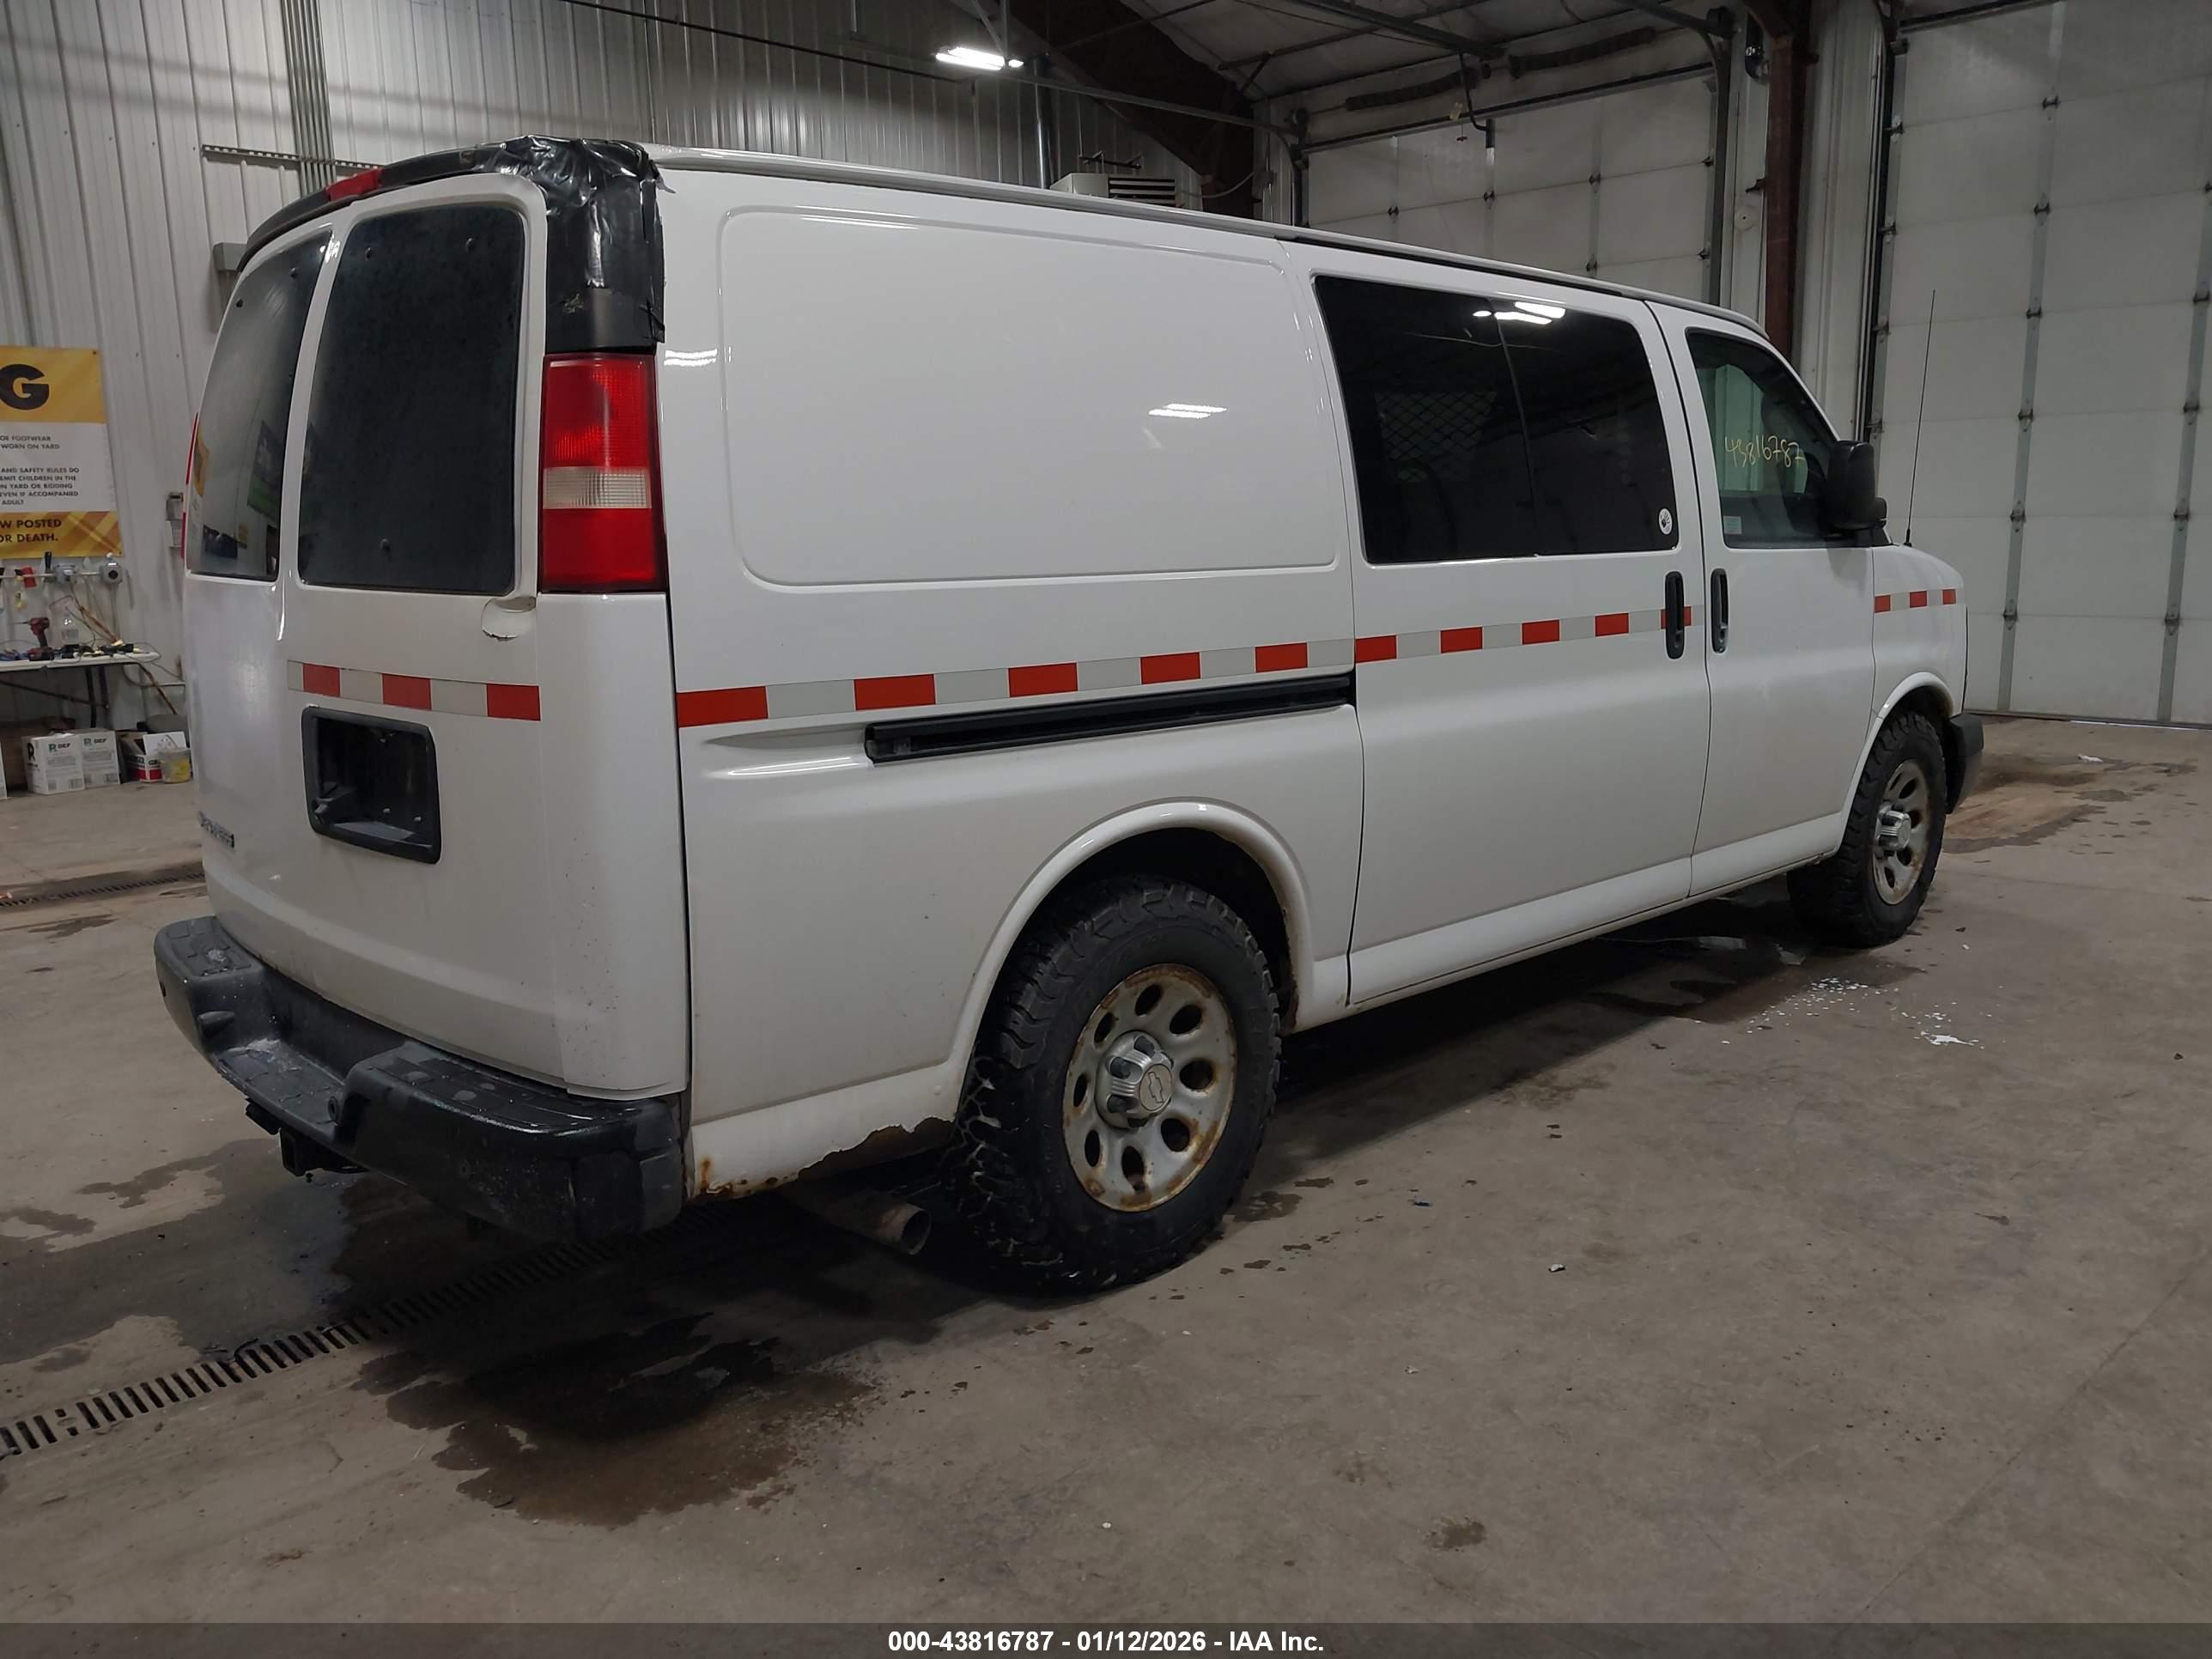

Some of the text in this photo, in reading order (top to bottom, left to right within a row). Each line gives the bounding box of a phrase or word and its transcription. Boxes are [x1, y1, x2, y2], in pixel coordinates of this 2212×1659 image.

[1724, 434, 1806, 468] 43816787
[16, 519, 62, 528] POSTED
[16, 532, 58, 543] DEATH.
